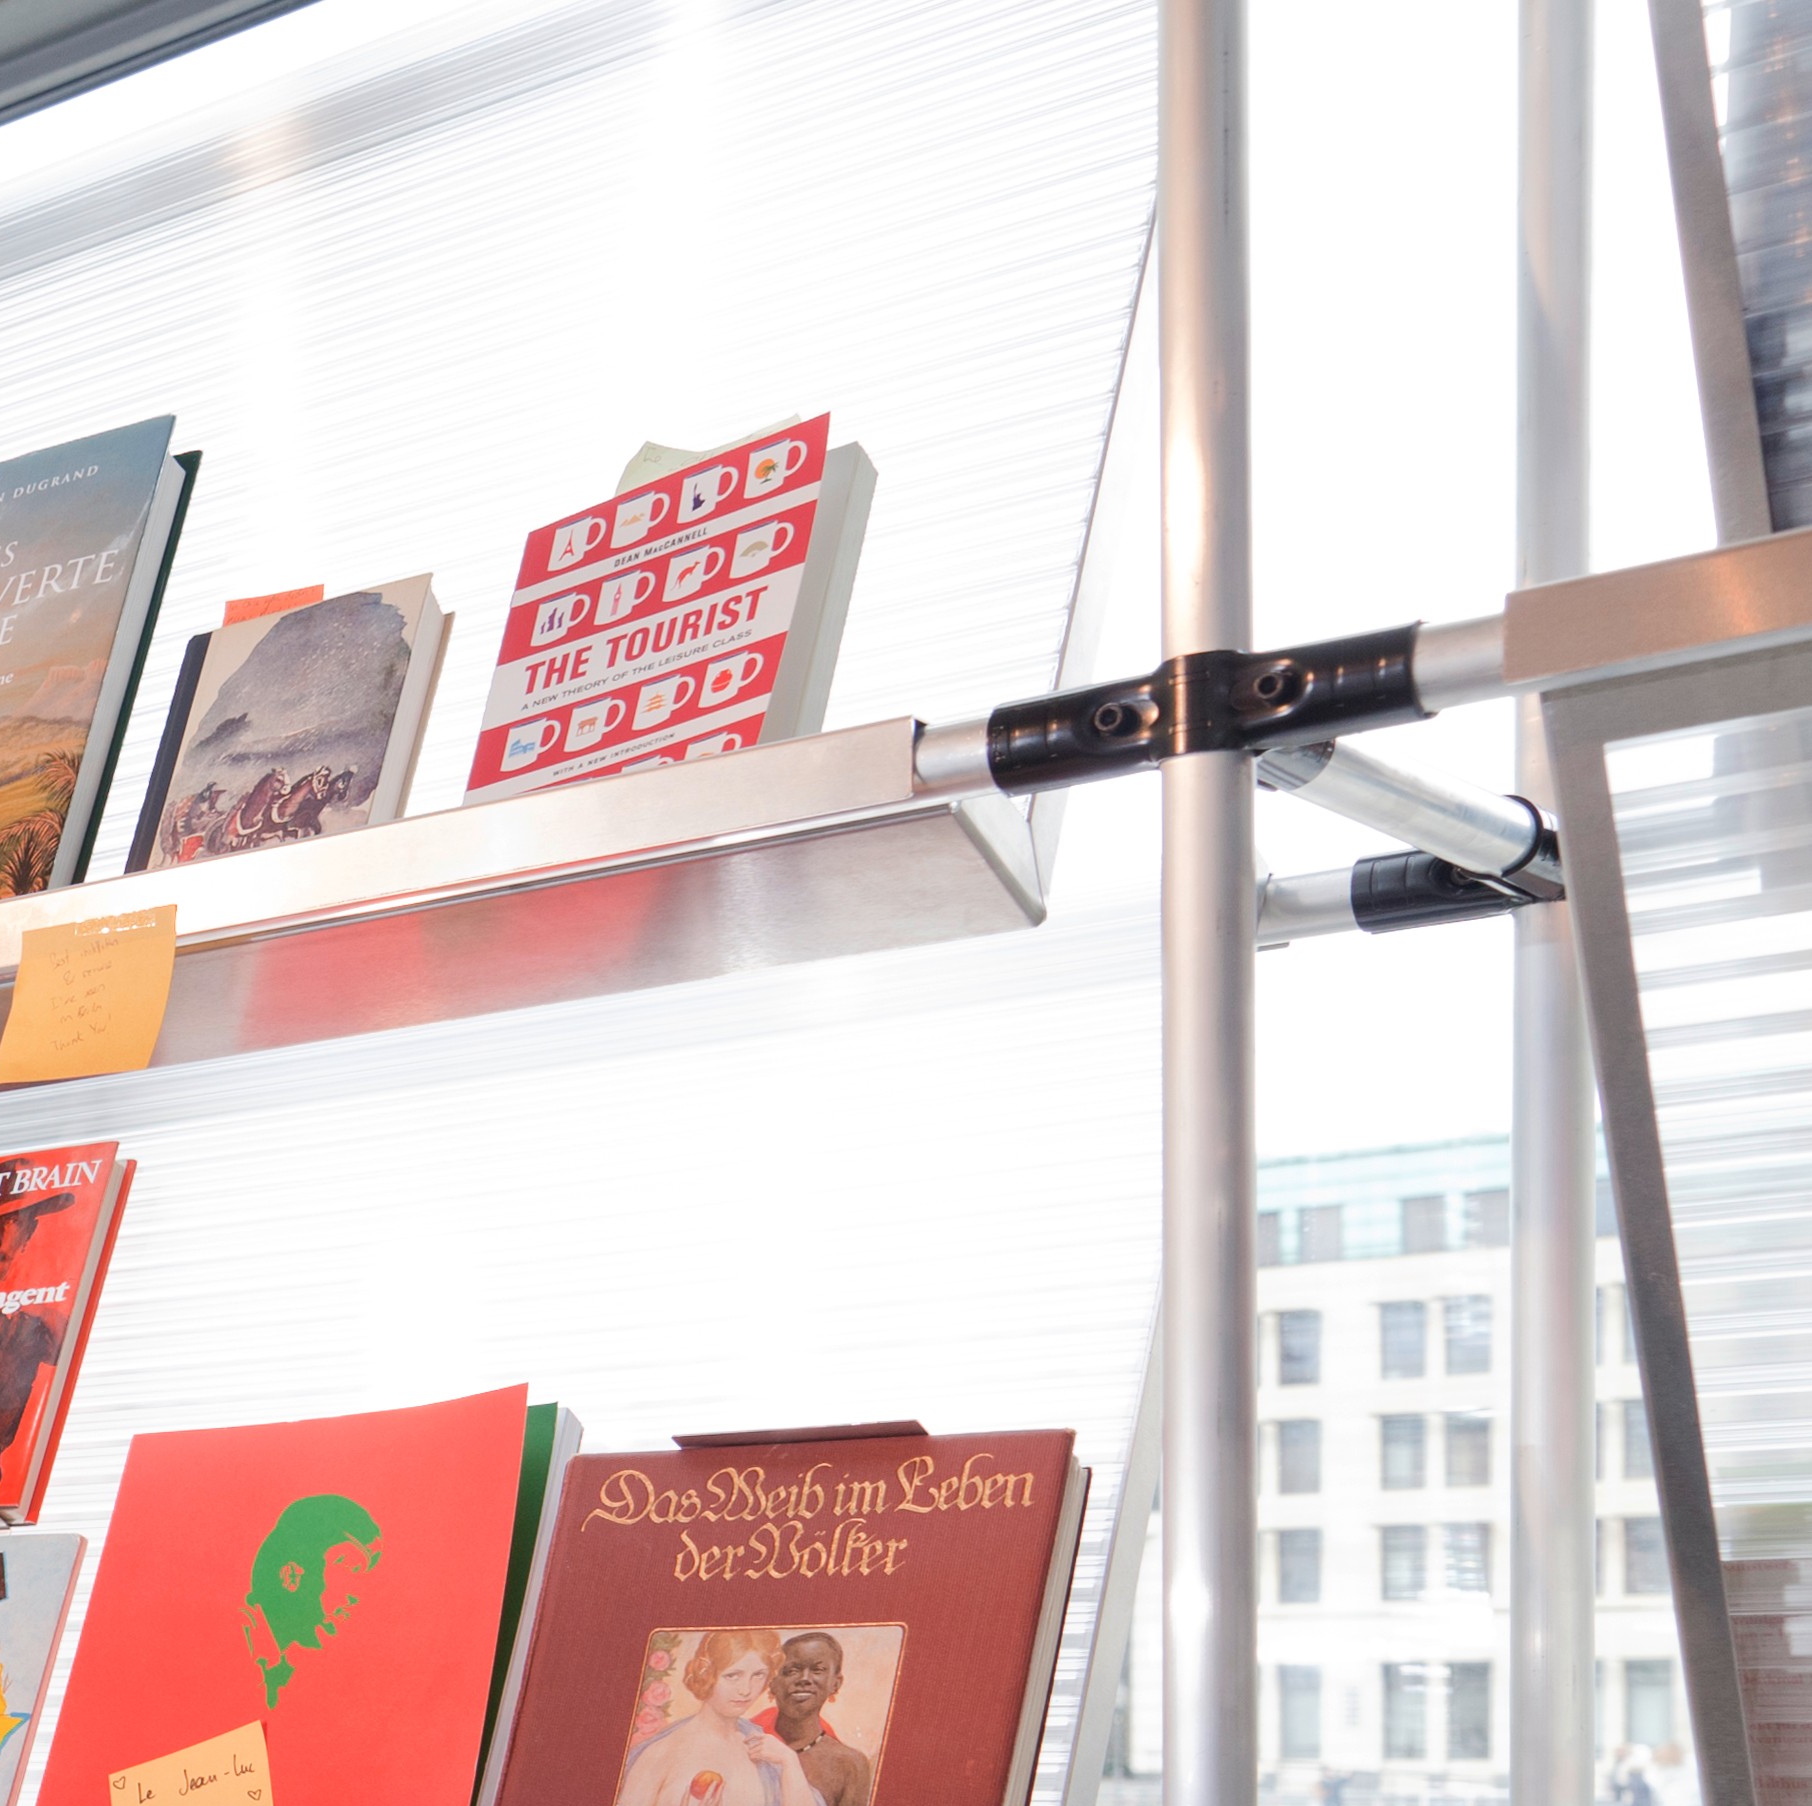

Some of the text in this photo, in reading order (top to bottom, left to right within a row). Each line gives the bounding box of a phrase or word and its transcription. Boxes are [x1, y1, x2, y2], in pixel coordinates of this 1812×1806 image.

[12, 464, 100, 499] DUGRAND
[613, 550, 641, 568] DEAN
[525, 585, 769, 695] THE TOURIST
[521, 629, 754, 711] A NEW THEORY OF THE LEISURE CLASS
[553, 766, 575, 777] WITH
[10, 1159, 103, 1195] BRAIN
[580, 1452, 1036, 1533] Das Weib im Leben
[673, 1529, 749, 1583] der
[137, 1782, 157, 1805] Le
